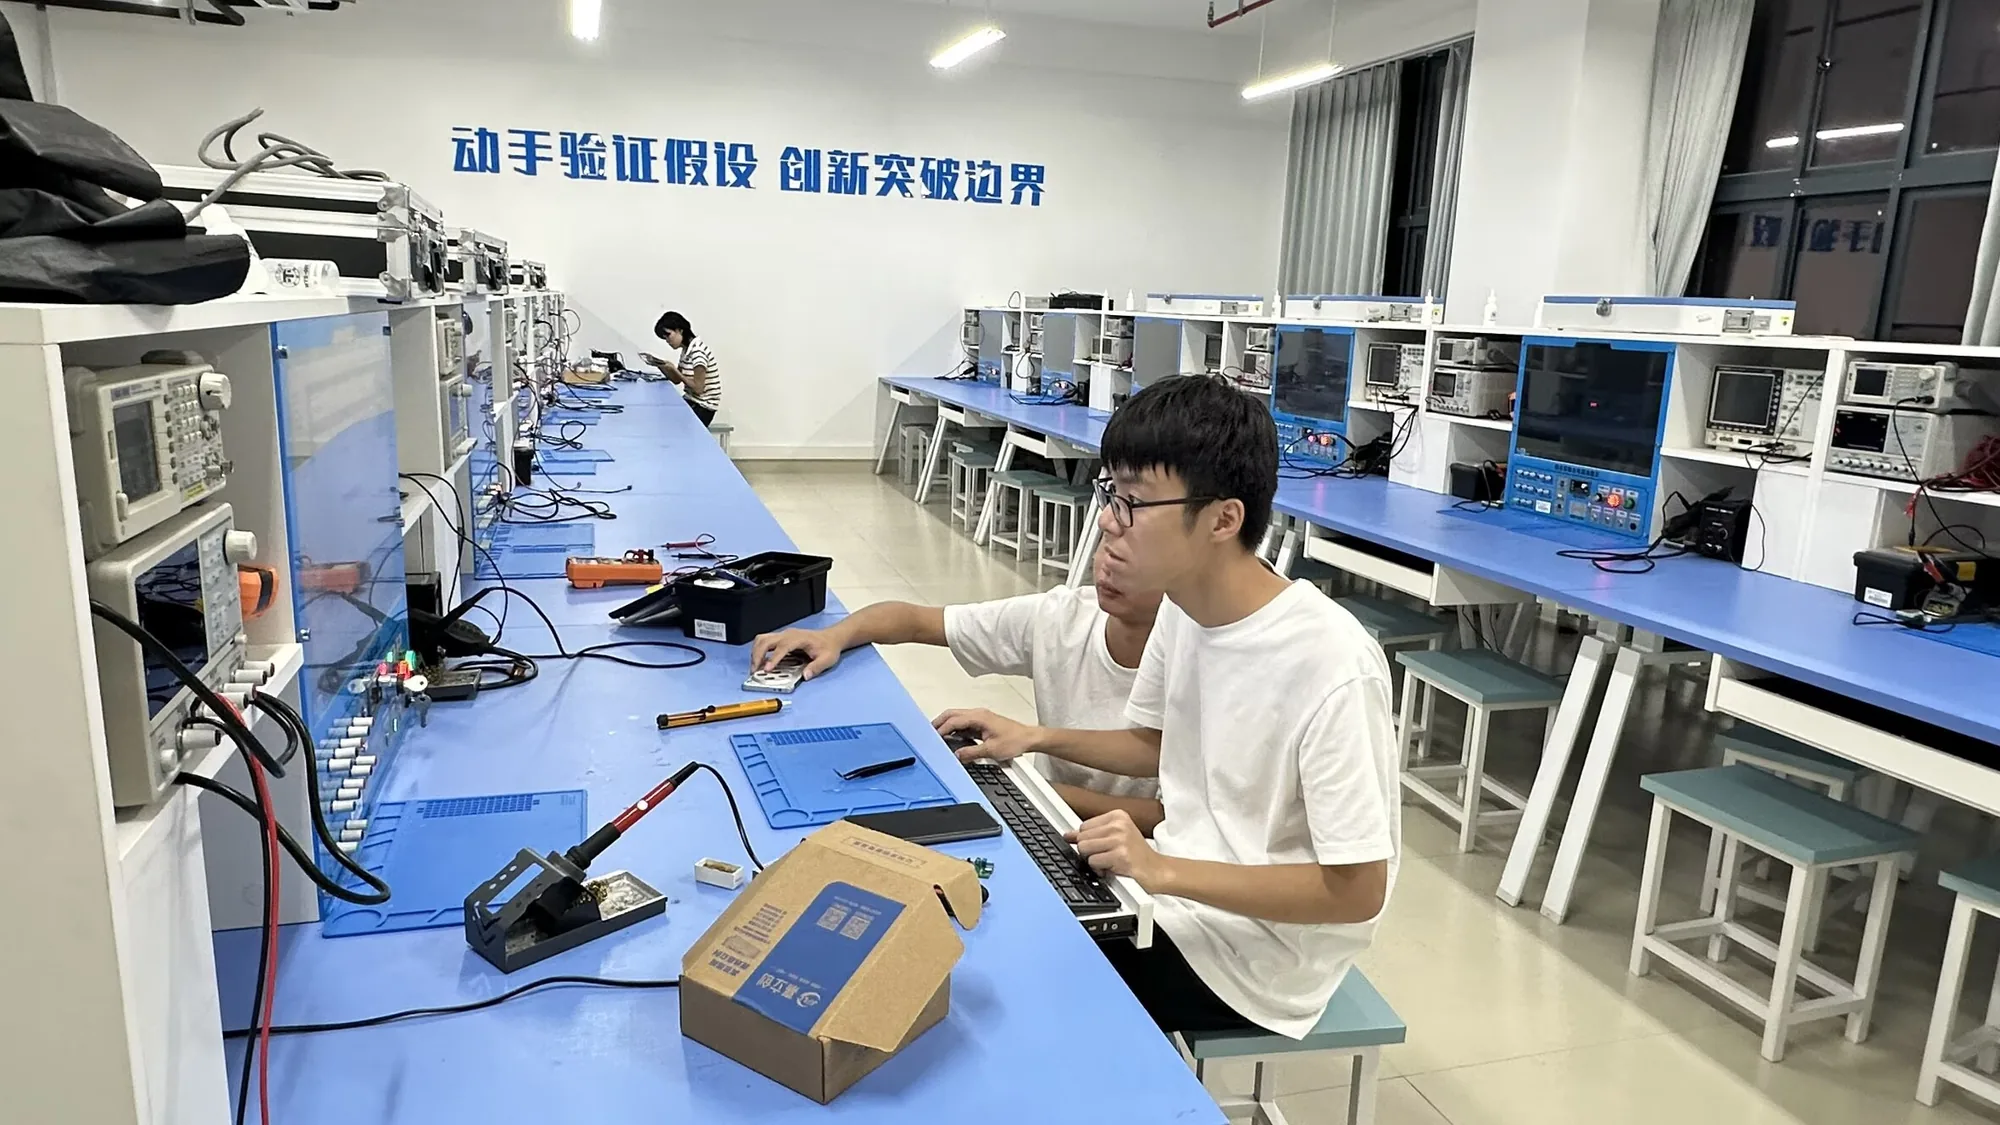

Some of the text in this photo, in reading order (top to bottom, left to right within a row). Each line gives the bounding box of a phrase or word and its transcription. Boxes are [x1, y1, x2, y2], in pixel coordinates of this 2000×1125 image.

[452, 127, 1045, 206] 动手验证假设 创新突破边界
